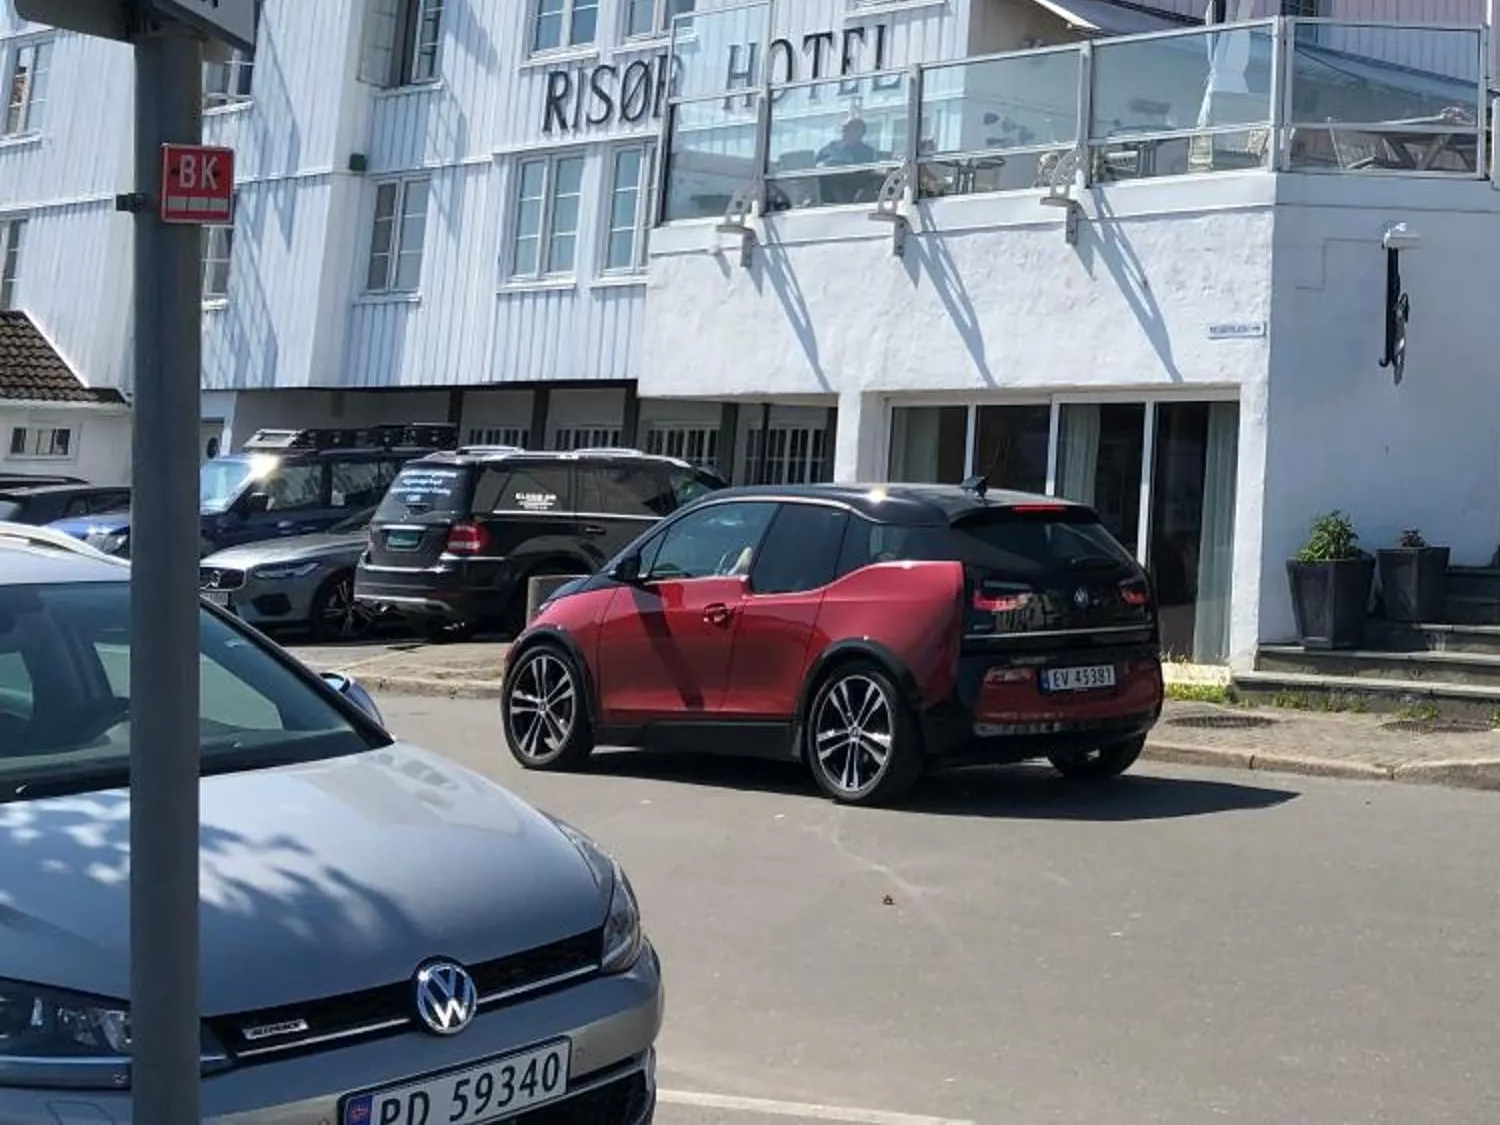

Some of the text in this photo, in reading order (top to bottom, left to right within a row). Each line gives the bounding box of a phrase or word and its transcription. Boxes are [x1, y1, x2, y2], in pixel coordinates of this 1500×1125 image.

[541, 24, 901, 138] RISØR HOTEL
[179, 154, 219, 190] BK
[1053, 670, 1069, 687] EV
[450, 1052, 561, 1123] 59340
